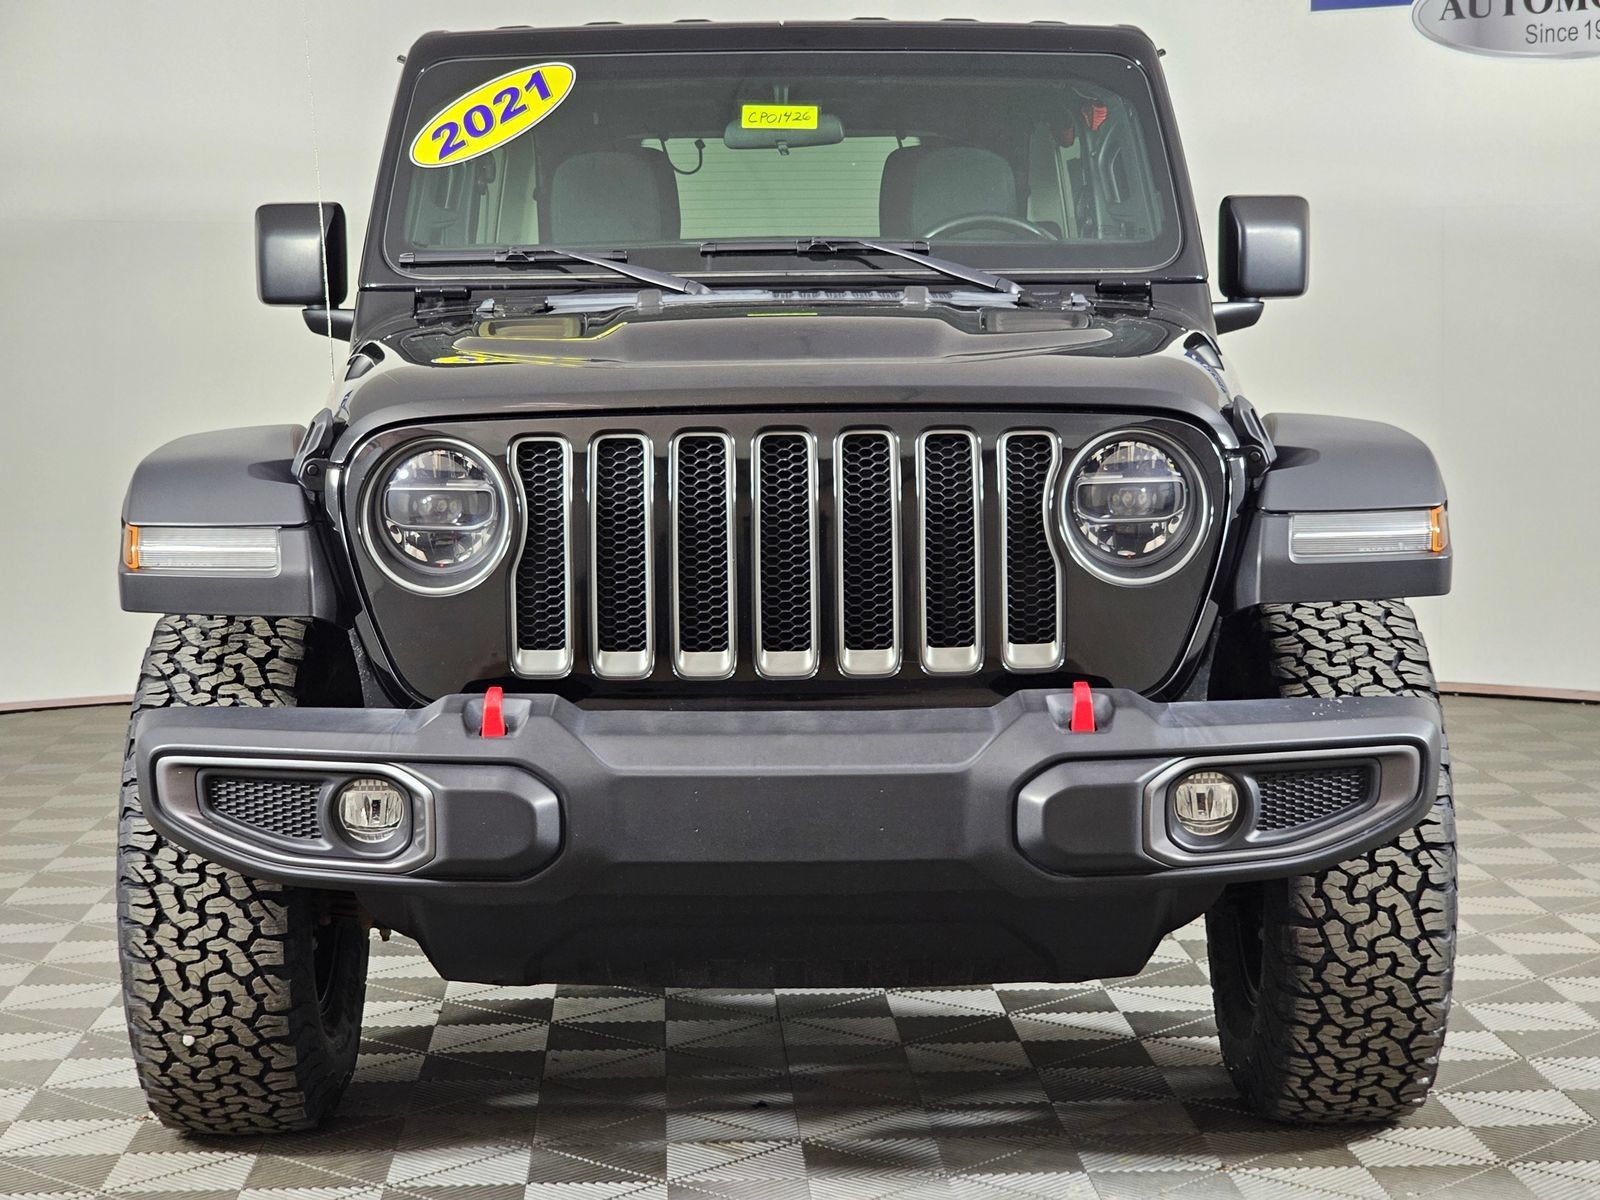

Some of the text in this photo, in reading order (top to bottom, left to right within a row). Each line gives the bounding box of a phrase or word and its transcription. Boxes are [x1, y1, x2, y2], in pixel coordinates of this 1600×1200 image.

[1439, 0, 1600, 20] AUTO
[1525, 23, 1579, 44] Since
[431, 70, 552, 160] 2021
